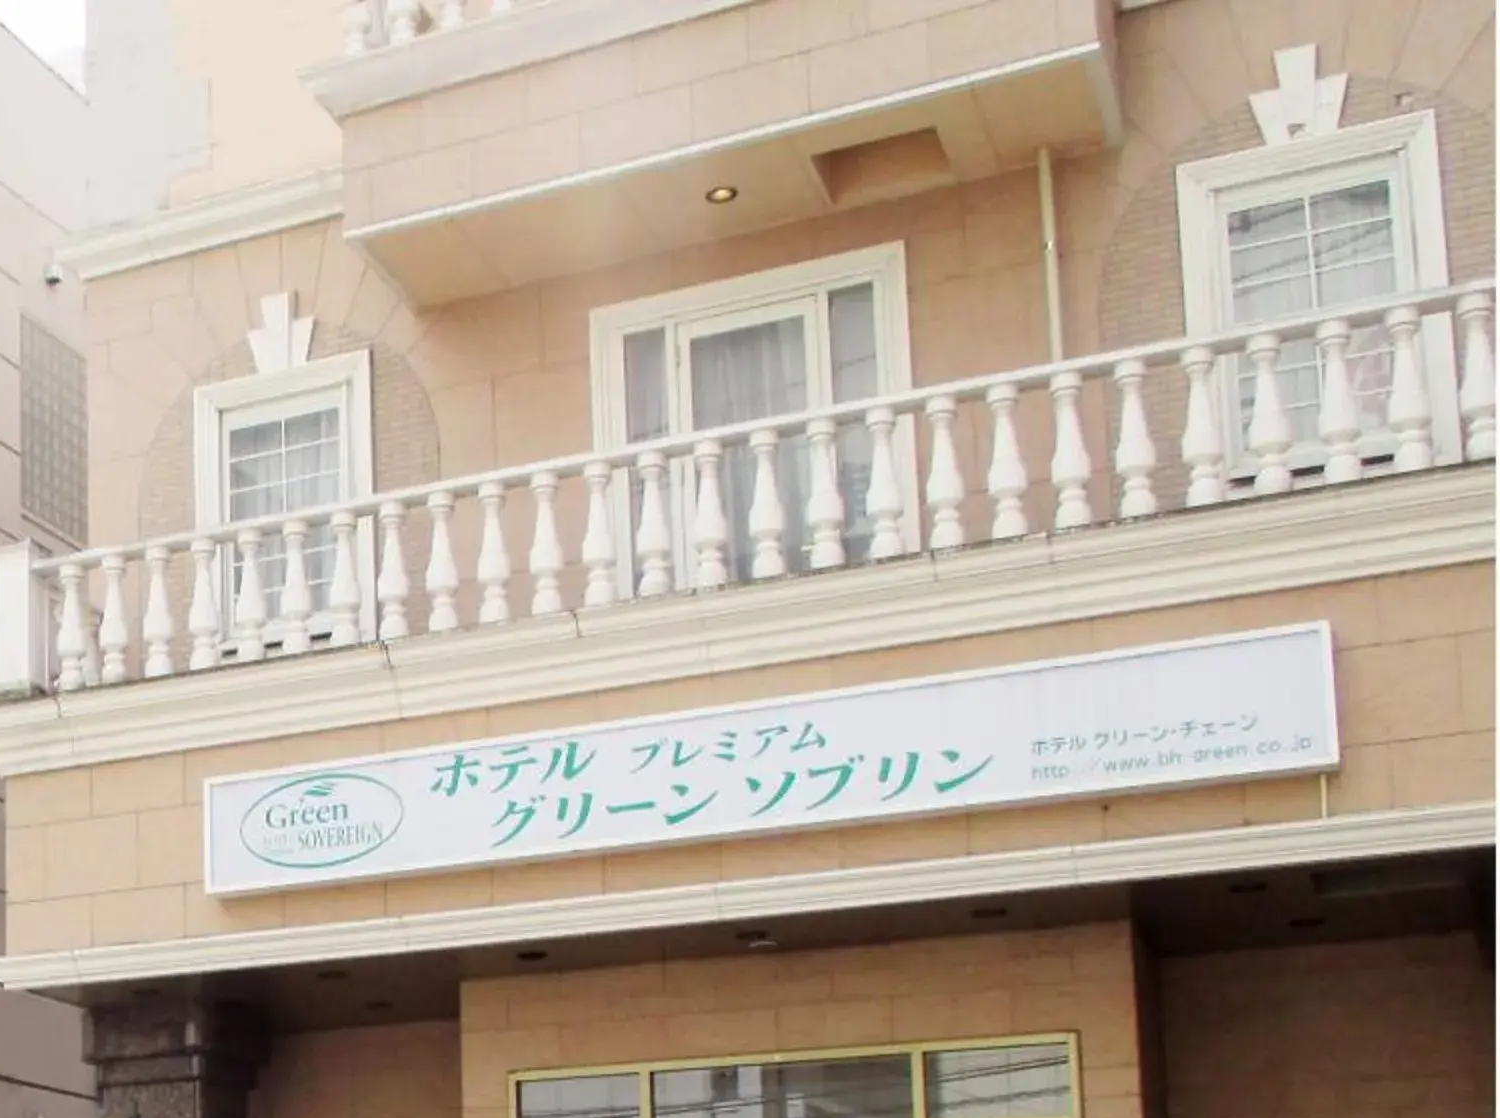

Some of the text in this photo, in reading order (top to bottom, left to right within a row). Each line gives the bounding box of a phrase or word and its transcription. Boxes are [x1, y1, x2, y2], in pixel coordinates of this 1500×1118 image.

[430, 721, 828, 797] ホテル プレミアム
[1030, 735, 1088, 756] ホテル
[265, 801, 349, 828] Green
[490, 749, 994, 848] グリーン ソブリン
